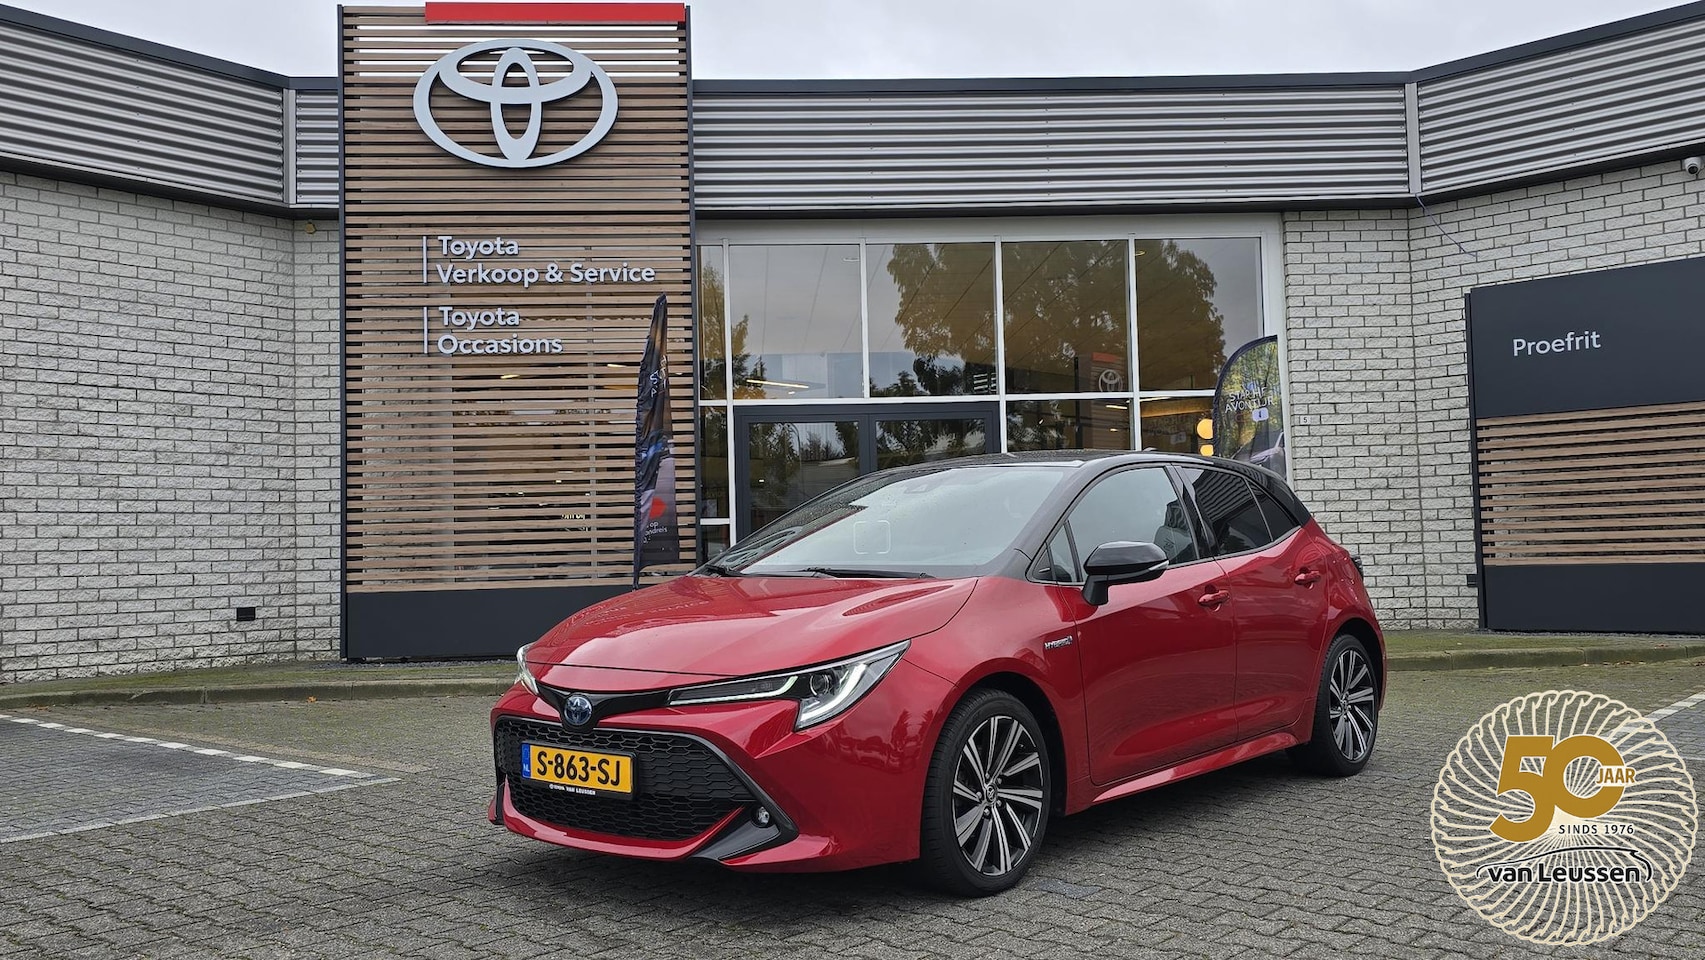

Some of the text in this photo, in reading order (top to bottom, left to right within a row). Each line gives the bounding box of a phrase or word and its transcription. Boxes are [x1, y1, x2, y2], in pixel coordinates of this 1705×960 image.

[437, 236, 519, 260] Toyota
[436, 262, 656, 288] Verkoop & Service
[438, 306, 520, 331] Toyota
[437, 333, 563, 354] Occasions
[1512, 330, 1601, 357] Proefrit
[1303, 416, 1308, 424] 5
[537, 750, 620, 787] S-863-SJ
